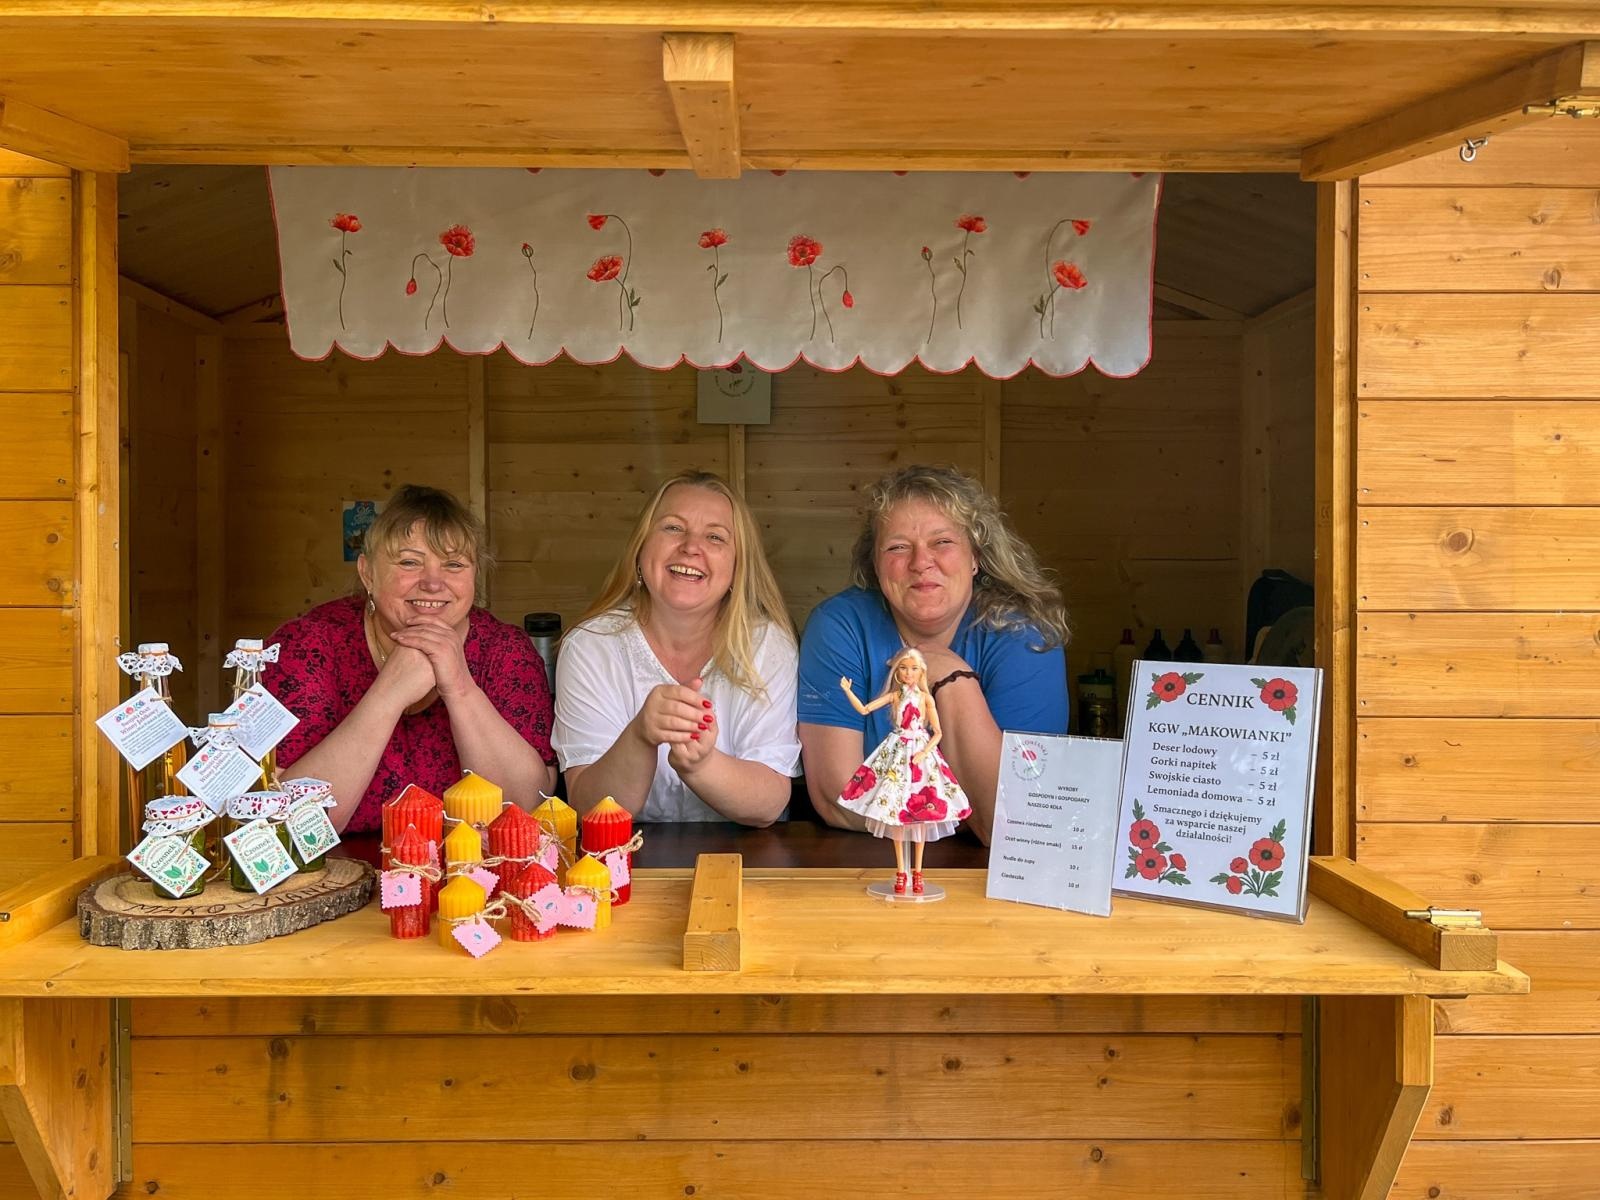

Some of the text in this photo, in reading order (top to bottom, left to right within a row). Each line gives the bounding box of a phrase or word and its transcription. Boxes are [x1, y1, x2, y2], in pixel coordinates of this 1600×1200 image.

[1187, 693, 1254, 709] CENNIK
[1149, 722, 1292, 743] KGW „MAKOWIANKI”
[1152, 742, 1180, 753] Deser
[1182, 744, 1218, 757] lodowy
[1262, 752, 1269, 760] 5
[1270, 752, 1280, 761] zł
[1151, 756, 1178, 767] Gorki
[1180, 760, 1217, 771] napitek
[1260, 766, 1267, 775] 5
[1269, 767, 1279, 776] zł
[1149, 770, 1191, 783] Swojskie
[1192, 774, 1222, 786] ciasto
[1259, 782, 1266, 790] 5
[1268, 782, 1277, 792] zł
[1147, 785, 1199, 799] Lemoniada
[1201, 790, 1243, 803] domowa
[1257, 796, 1265, 805] 5
[1266, 797, 1276, 807] zł
[1153, 804, 1262, 825] Smacznego i dziękujemy
[1164, 818, 1247, 835] za wsparcie naszej
[1176, 829, 1233, 844] działalności!
[151, 845, 176, 869] Czosnek
[122, 880, 345, 916] MAKOWIANKI
